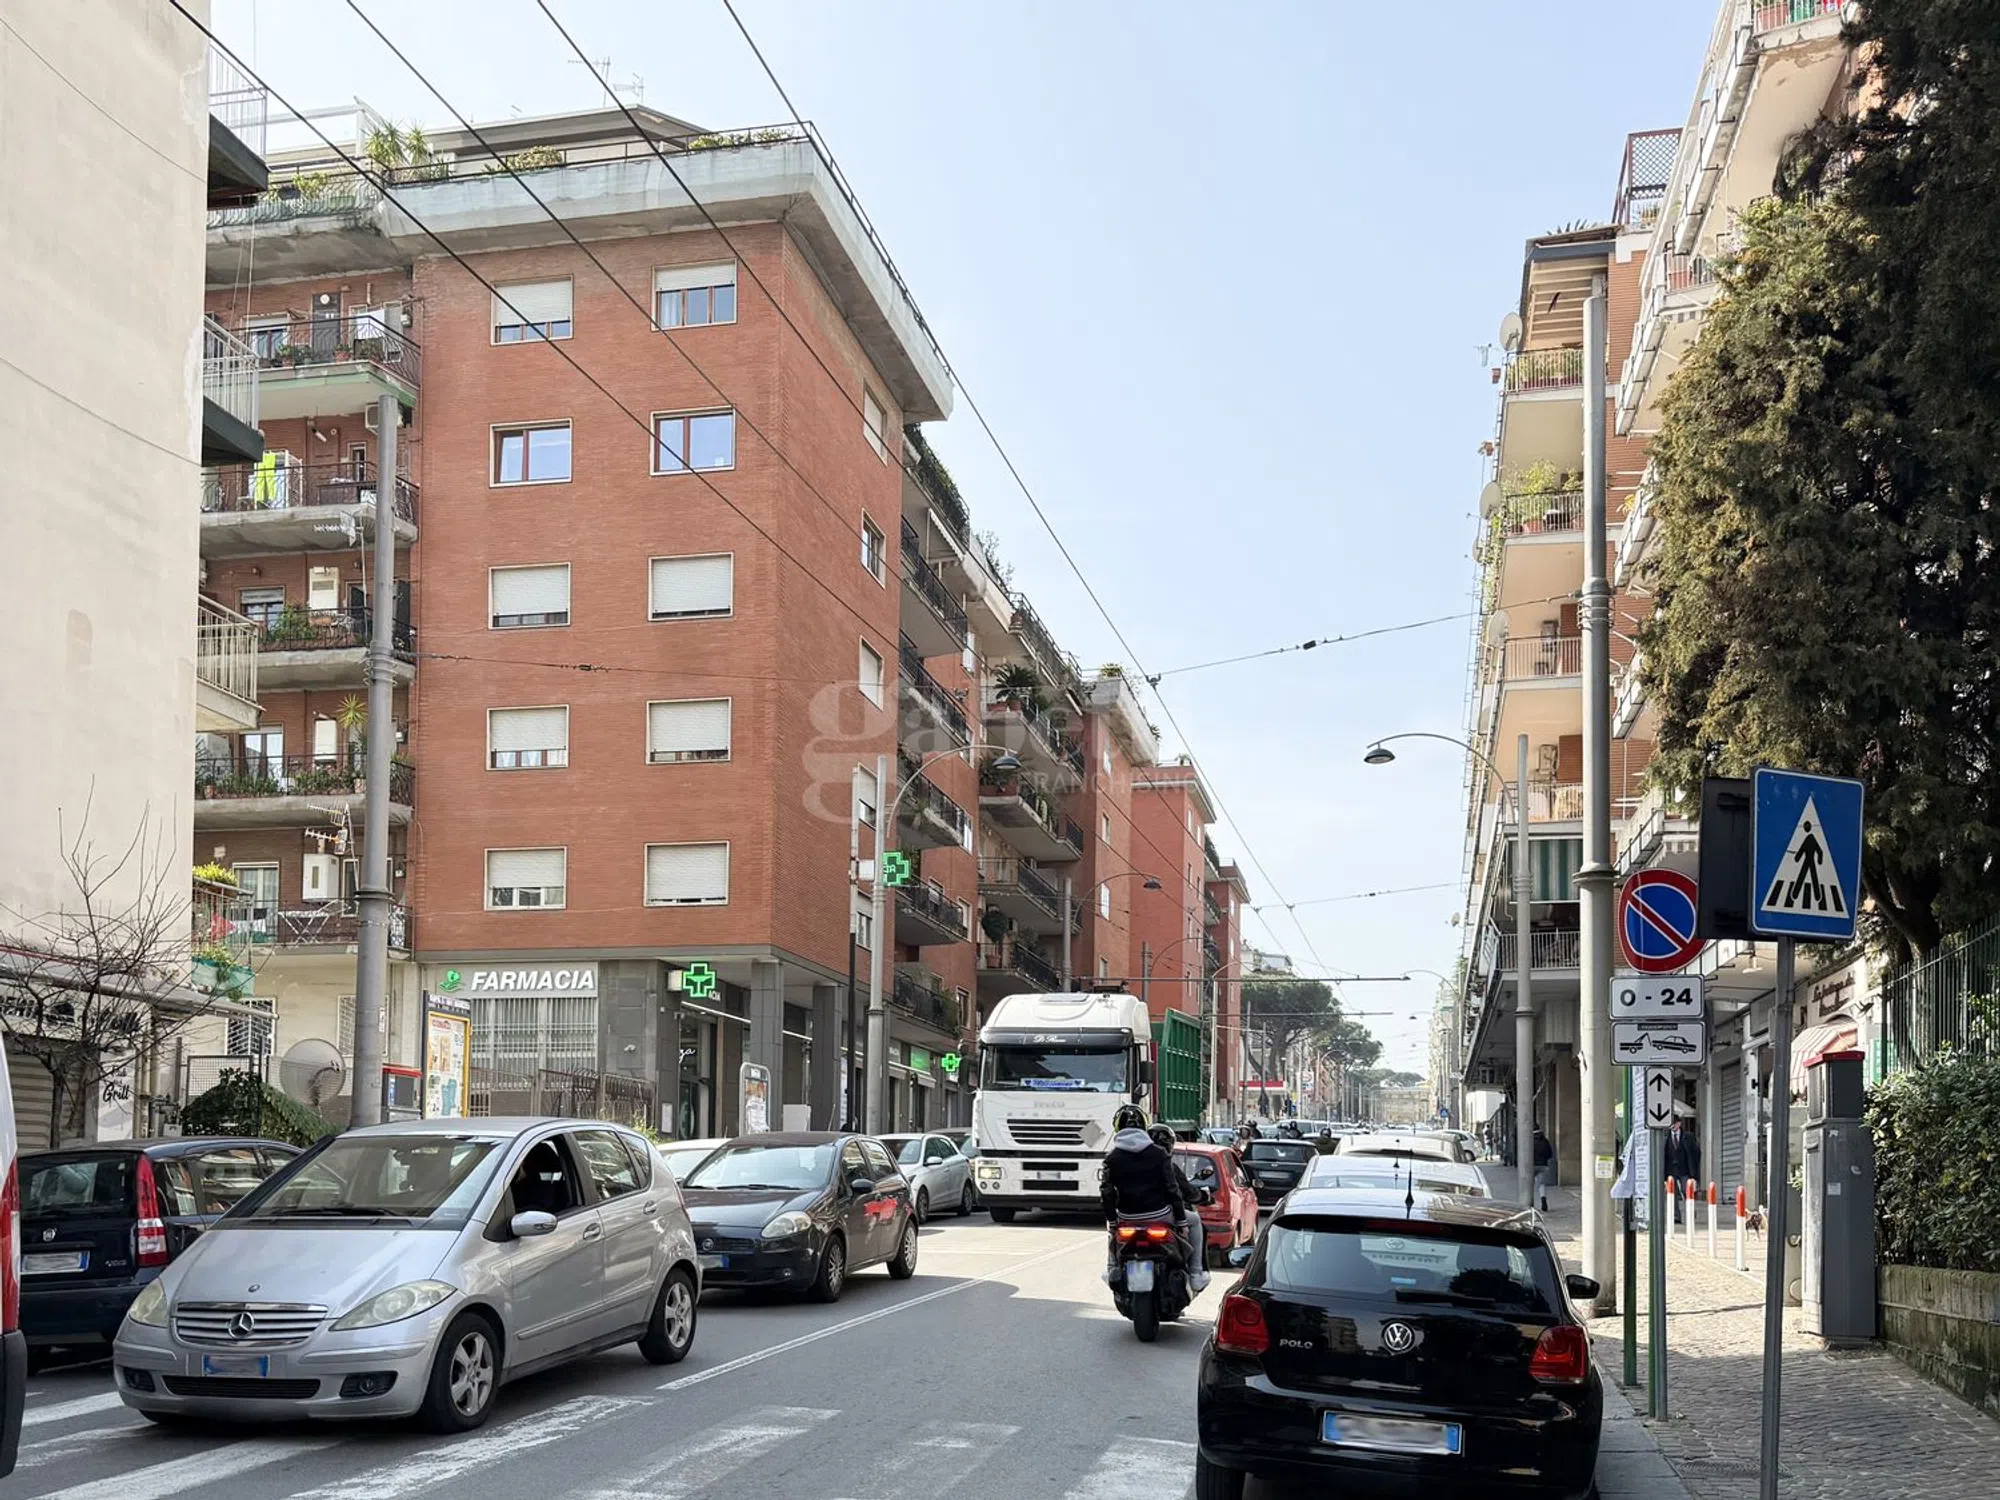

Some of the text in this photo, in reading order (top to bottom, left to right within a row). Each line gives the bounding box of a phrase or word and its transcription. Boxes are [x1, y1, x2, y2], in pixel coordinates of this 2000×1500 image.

[471, 970, 595, 992] FARMACIA
[1661, 988, 1693, 1006] 24
[103, 1082, 129, 1102] Grill
[1279, 1338, 1313, 1350] POLO
